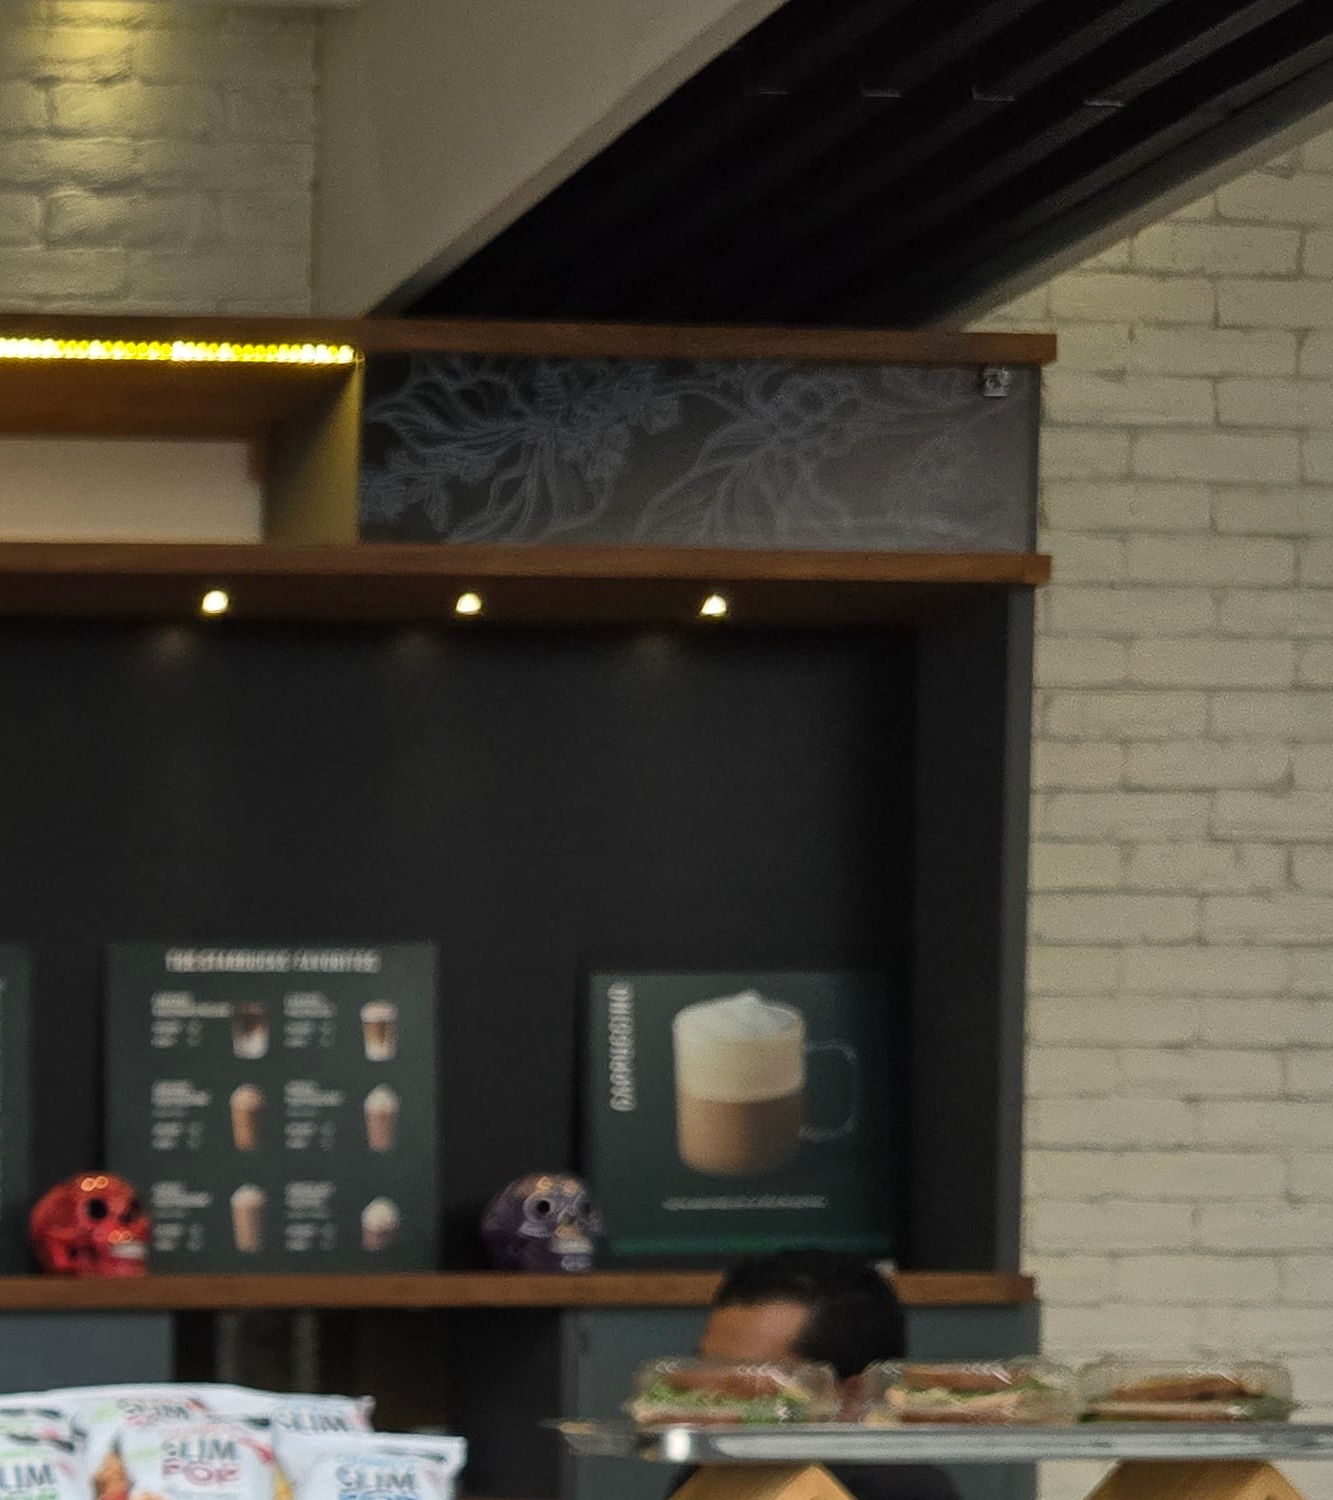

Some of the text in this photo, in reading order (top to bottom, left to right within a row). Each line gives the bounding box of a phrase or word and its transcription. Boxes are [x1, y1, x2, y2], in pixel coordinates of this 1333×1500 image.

[161, 1438, 238, 1461] SLIM
[162, 1458, 241, 1485] POP
[335, 1465, 416, 1491] SLIM
